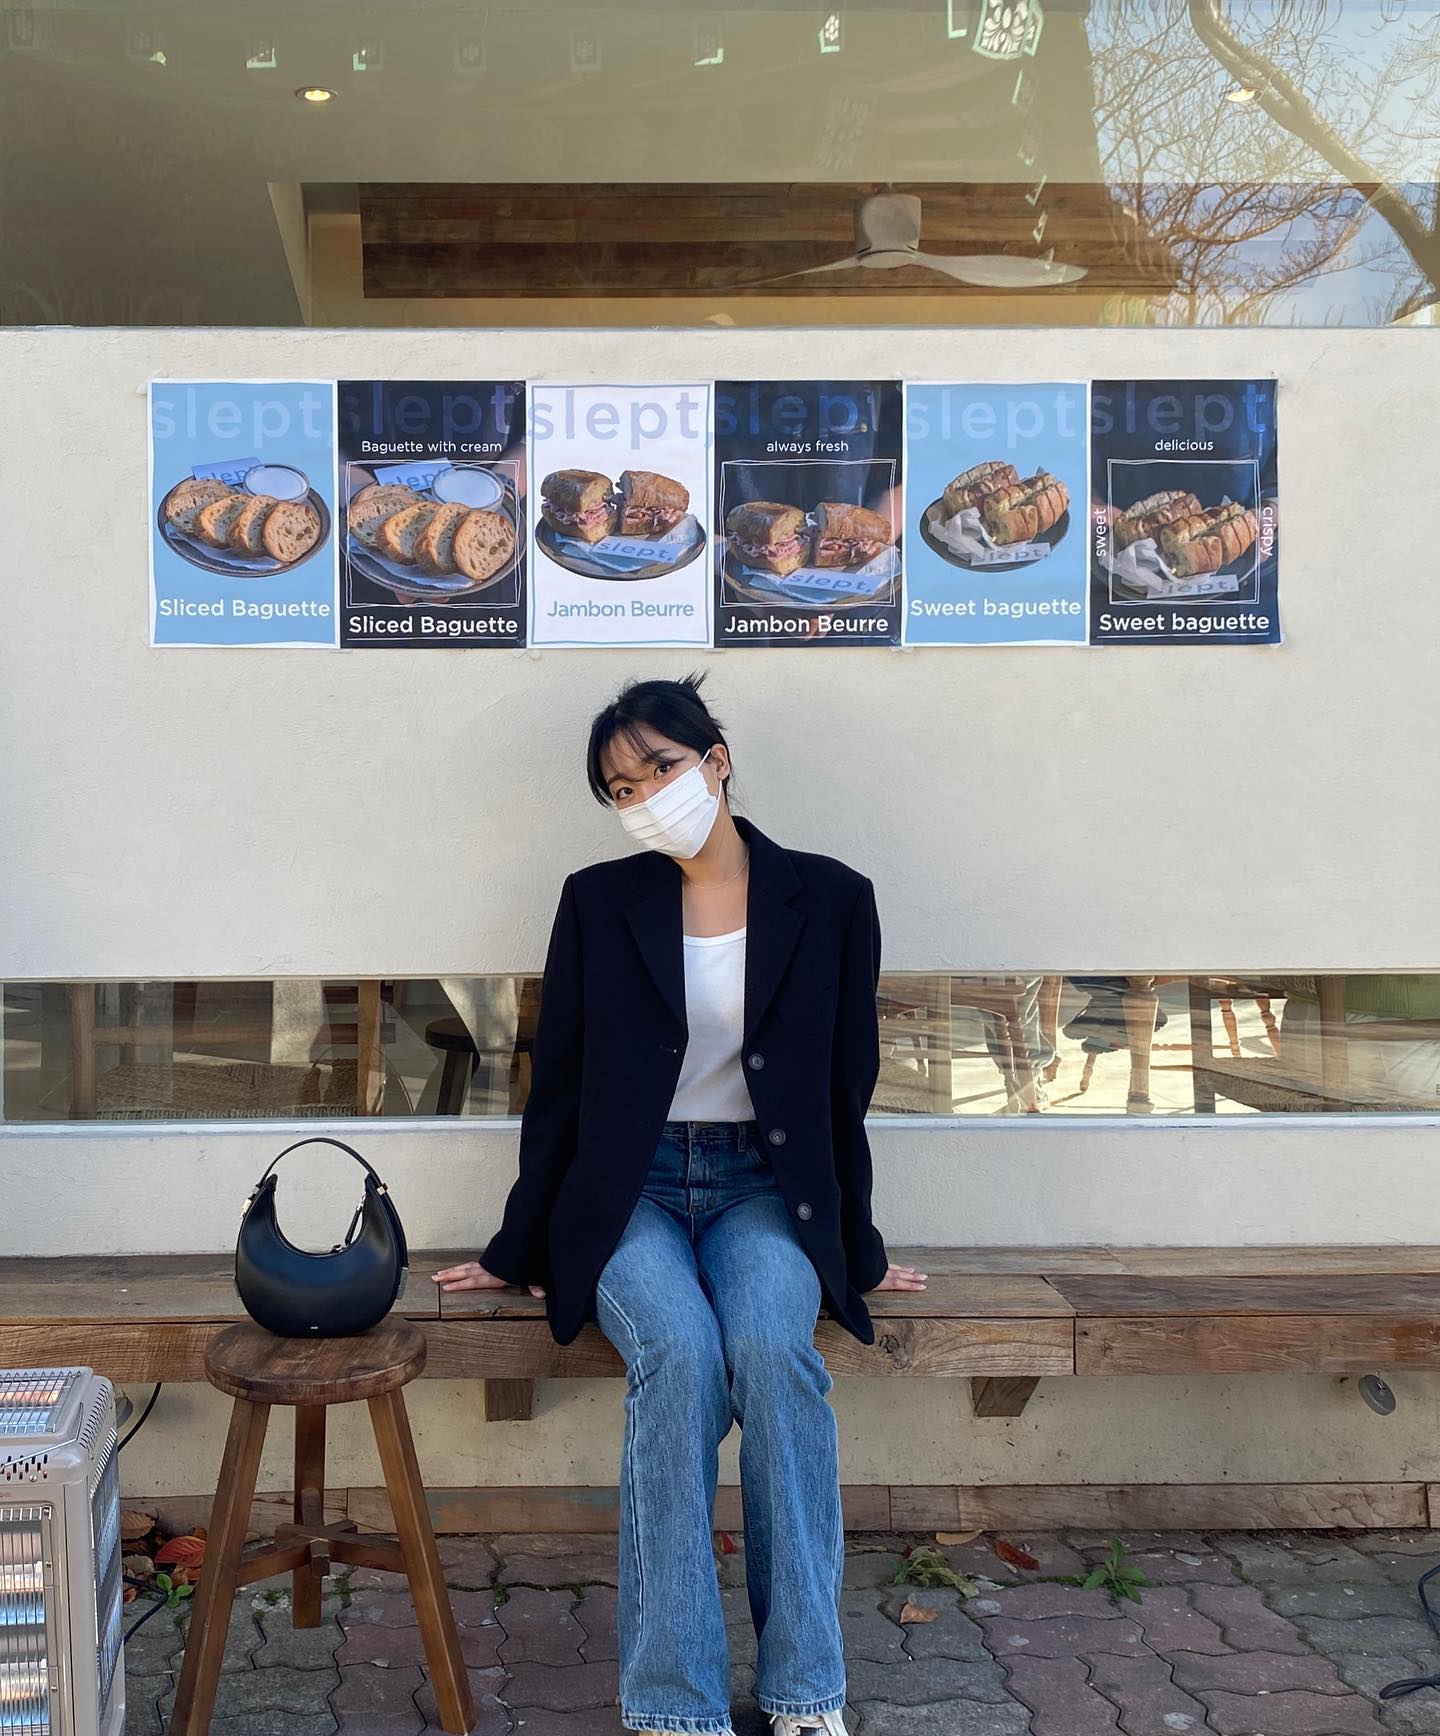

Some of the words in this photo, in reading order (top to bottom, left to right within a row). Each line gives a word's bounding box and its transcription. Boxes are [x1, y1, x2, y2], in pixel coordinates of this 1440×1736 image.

[361, 440, 424, 454] Baguette
[427, 440, 456, 452] with
[460, 442, 502, 452] cream
[766, 440, 811, 454] always
[816, 440, 849, 452] fresh
[1154, 439, 1214, 451] delicious
[1094, 508, 1107, 557] sweet
[1260, 506, 1274, 556] crispy
[597, 542, 673, 561] slept,
[788, 574, 872, 593] slept,
[159, 599, 224, 617] Sliced
[232, 600, 331, 620] Baguette
[547, 600, 626, 617] Jambon
[631, 600, 695, 617] Beurre
[910, 599, 976, 616] Sweet
[983, 598, 1081, 619] baguette
[349, 615, 413, 633] Sliced
[421, 616, 518, 636] Baguette
[724, 615, 810, 633] Jambon
[818, 615, 889, 633] Beurre
[1099, 613, 1165, 631] Sweet
[1172, 612, 1270, 633] baguette
